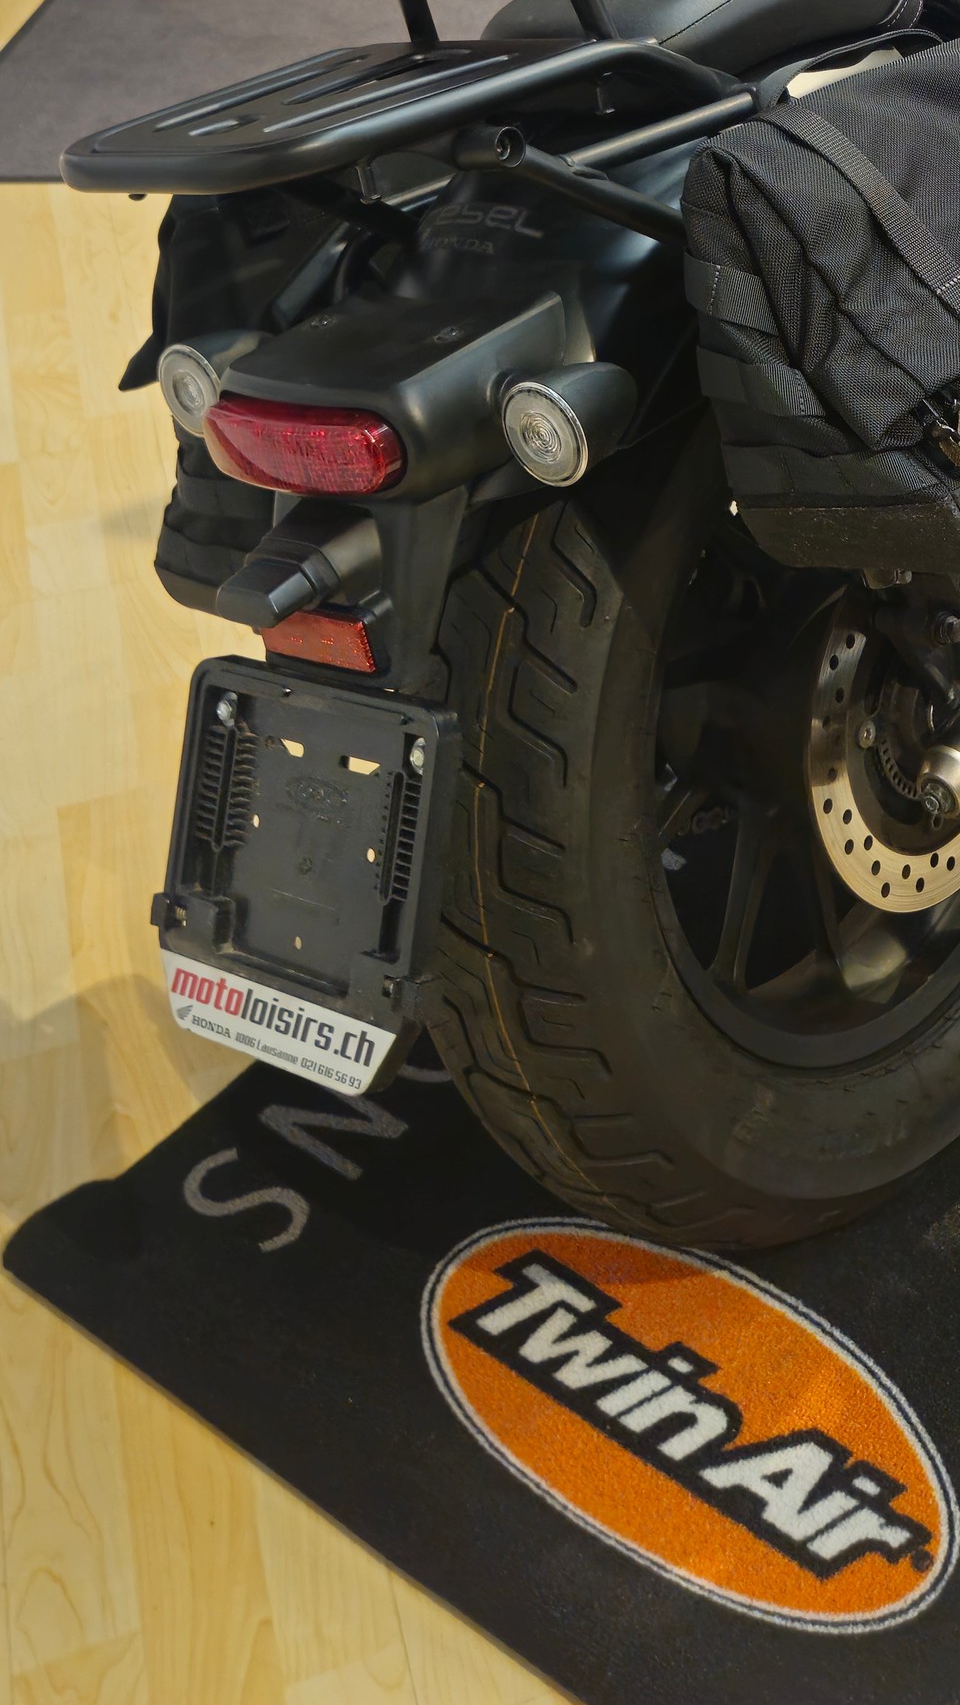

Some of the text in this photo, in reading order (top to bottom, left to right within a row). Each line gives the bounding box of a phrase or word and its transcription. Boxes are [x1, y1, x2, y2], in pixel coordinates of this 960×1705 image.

[170, 967, 376, 1068] motoloisirs.ch
[191, 1014, 231, 1039] HONDA
[235, 1032, 256, 1049] 1006
[256, 1039, 299, 1066] Lausanne
[335, 1069, 349, 1085] 56
[348, 1075, 363, 1090] 93
